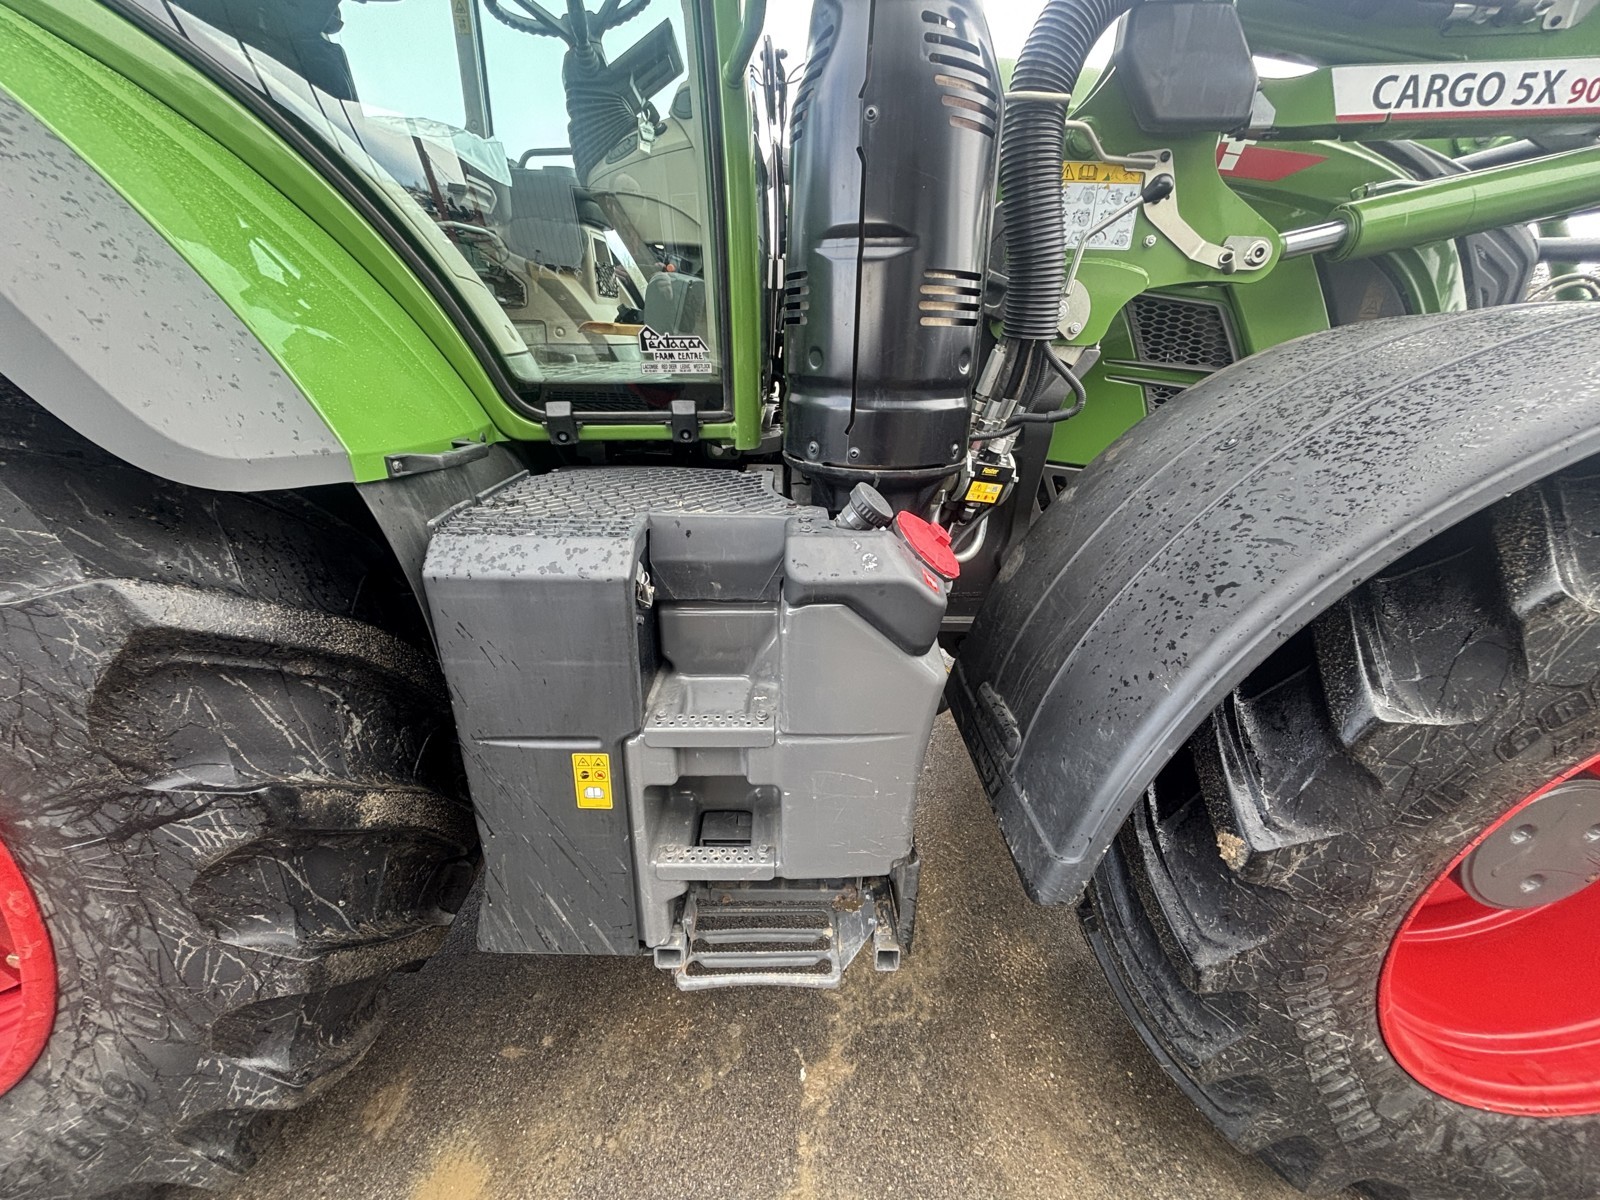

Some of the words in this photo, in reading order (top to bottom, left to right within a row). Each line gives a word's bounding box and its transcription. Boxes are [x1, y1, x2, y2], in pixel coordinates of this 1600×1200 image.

[1372, 71, 1506, 110] CARGO
[1511, 69, 1567, 106] 5X
[655, 352, 675, 360] FARM
[678, 351, 703, 360] CENTRE
